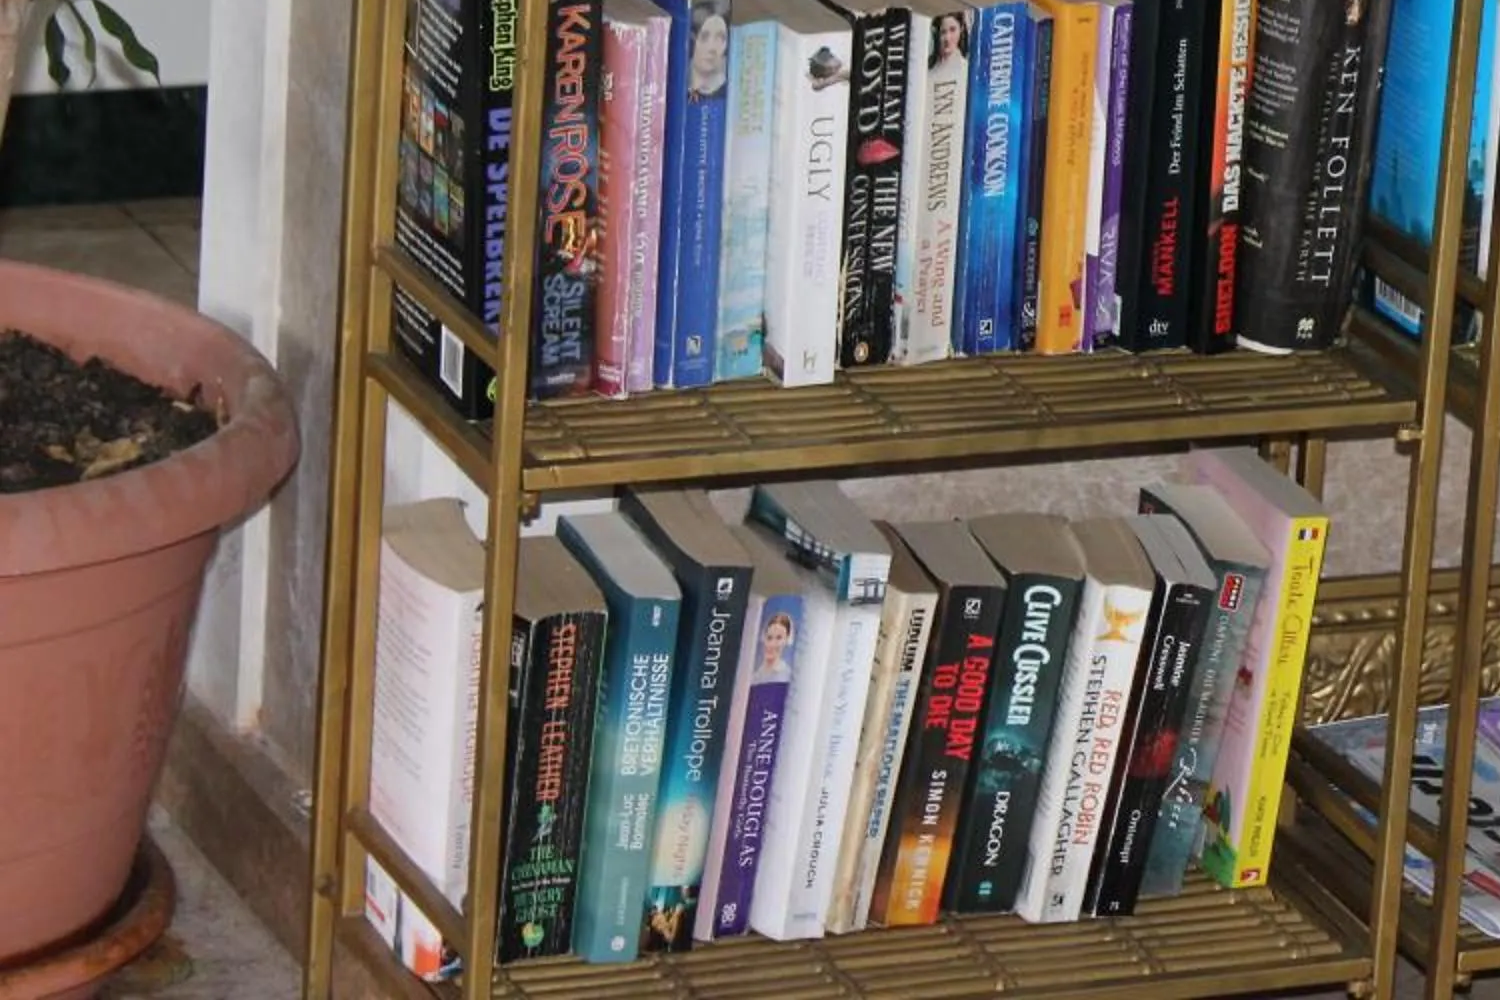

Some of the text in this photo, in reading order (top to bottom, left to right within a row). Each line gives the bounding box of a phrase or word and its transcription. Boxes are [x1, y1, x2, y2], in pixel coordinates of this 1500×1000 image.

[489, 47, 515, 91] King
[858, 24, 884, 133] BOYD
[882, 23, 906, 135] WILLIAM
[981, 12, 1014, 198] CATHERINE COOKSON
[1168, 38, 1188, 174] Der Feind im Schatten
[545, 4, 592, 246] KAREN ROSE
[807, 115, 834, 201] UGLY
[927, 80, 957, 212] LYN ANDREWS
[1225, 72, 1247, 163] NACKTE
[1222, 168, 1240, 212] DAS
[1312, 45, 1361, 286] KEN FOLLETT
[483, 108, 512, 336] DE SPELBREK
[845, 174, 869, 319] CONFESSIONS
[871, 171, 899, 275] THE NEW
[1099, 226, 1115, 286] RIVA
[1158, 197, 1179, 296] MANKELL
[1299, 229, 1316, 282] EARTH
[541, 273, 564, 364] SCREAM
[558, 275, 586, 360] SILENT
[917, 240, 932, 313] a Prayer
[932, 220, 952, 327] A Wing and
[1215, 224, 1238, 334] SHELDON
[1148, 319, 1169, 336] dtv
[900, 608, 925, 672] LUDLUM
[1005, 585, 1061, 726] CLIVE CUSSLER
[1153, 635, 1174, 690] Cresswell
[1171, 642, 1191, 687] Jasmine
[1191, 615, 1229, 745] DAPHNE DU MAURIER
[536, 624, 577, 801] STEPHEN LEATHER
[621, 654, 650, 775] BRETONISCHE
[685, 608, 730, 781] Joanna Trollope
[893, 680, 912, 709] THE
[925, 662, 960, 729] TO DIE
[944, 635, 993, 760] A GOOD DAY
[738, 710, 778, 867] ANNE DOUGLAS
[748, 740, 757, 763] The
[1051, 655, 1106, 877] STEPHEN GALLAGHER
[1088, 737, 1113, 776] RED
[530, 845, 555, 859] THE
[617, 793, 634, 850] Jean-Luc
[631, 793, 649, 850] Bannalec
[815, 787, 831, 826] JULIA
[905, 770, 946, 912] SIMON KERNICK
[983, 790, 1011, 866] DRAGON
[1072, 782, 1103, 845] ROBIN
[805, 831, 823, 889] CROUCH
